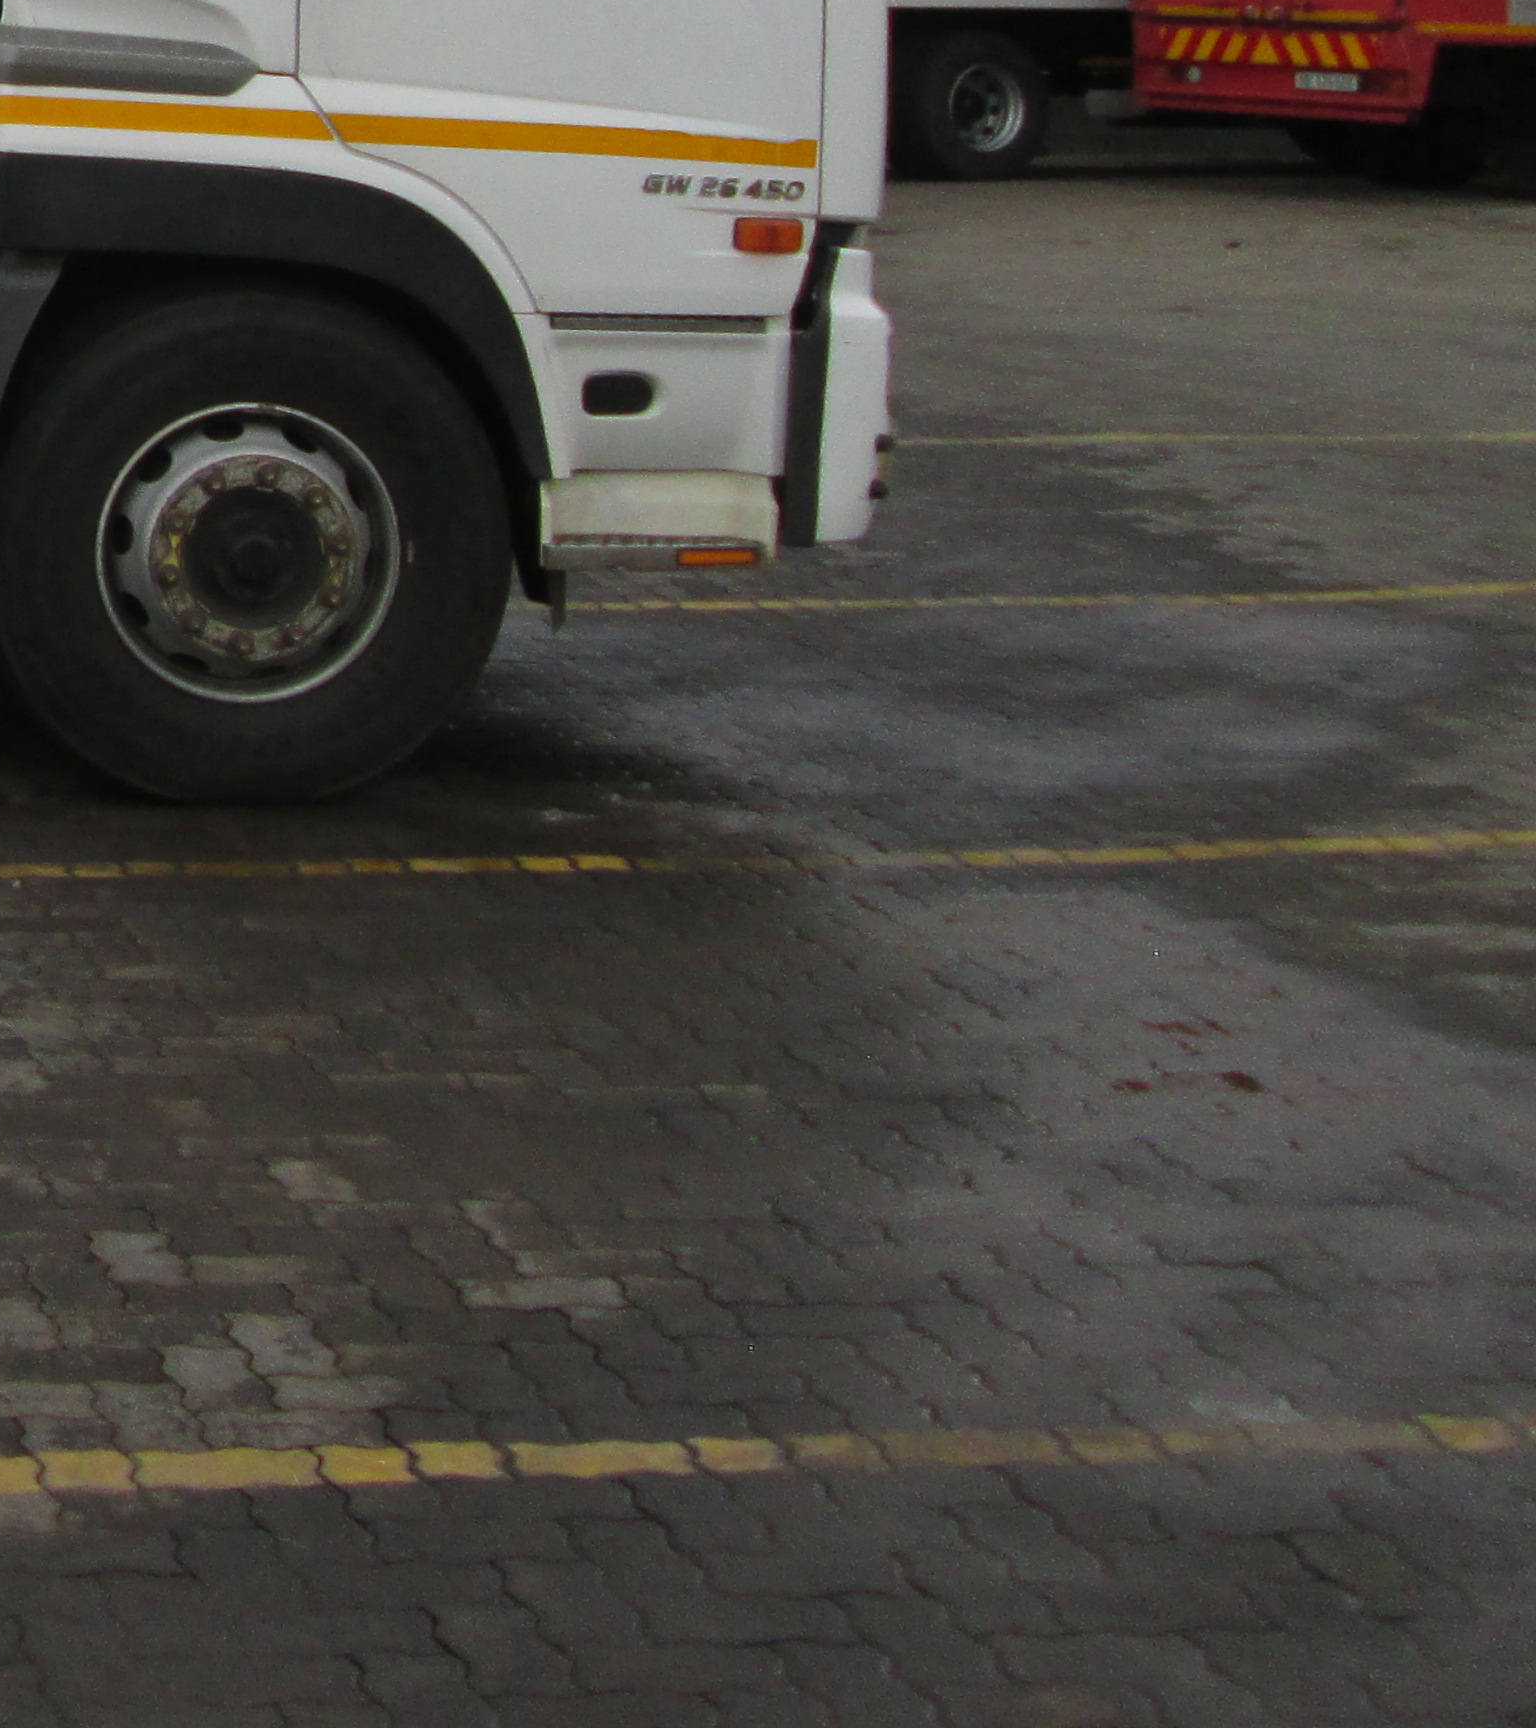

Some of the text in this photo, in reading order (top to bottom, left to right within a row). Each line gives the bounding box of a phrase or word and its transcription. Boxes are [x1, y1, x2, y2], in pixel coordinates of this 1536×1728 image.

[642, 173, 805, 201] GW 26 450
